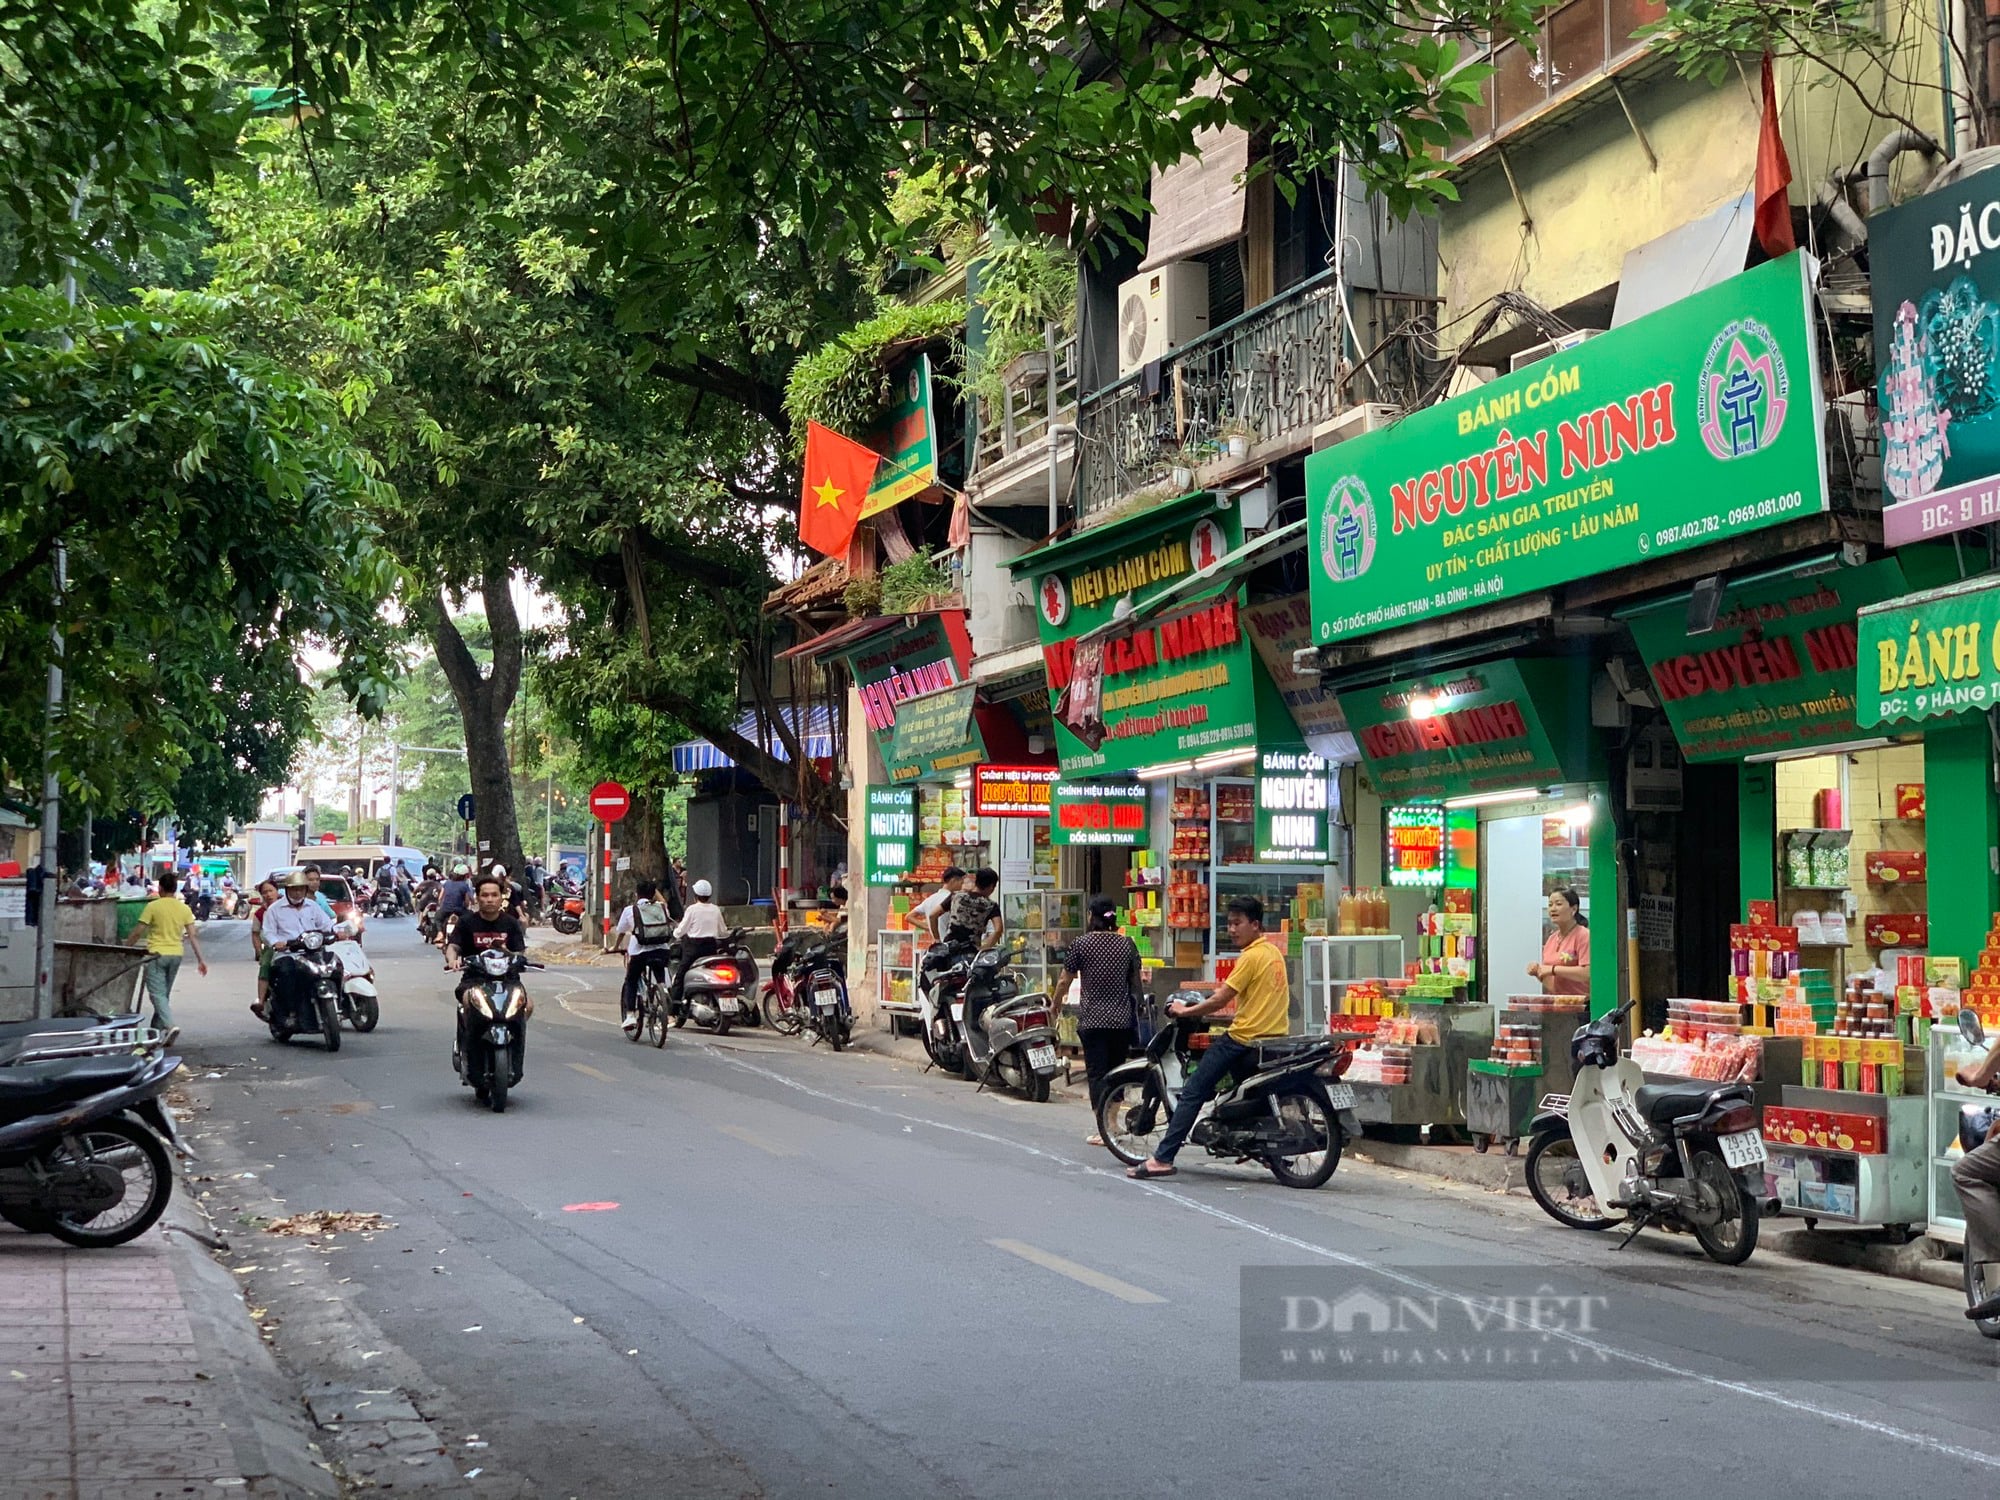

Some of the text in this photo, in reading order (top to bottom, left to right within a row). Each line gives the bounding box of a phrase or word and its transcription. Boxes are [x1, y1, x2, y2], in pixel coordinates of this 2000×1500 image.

[1930, 201, 2000, 271] ĐẶC
[1457, 364, 1580, 436] BÁNH CỐM
[1390, 428, 1549, 536] NGUYÊN
[1557, 382, 1678, 480] NINH
[1443, 476, 1615, 548] ĐẶC SẢN GIA TRUYỀN
[1655, 513, 1720, 547] 0987.402.782
[1728, 491, 1803, 526] 0969.081.000
[1922, 504, 1953, 532] ĐC:
[1960, 496, 1973, 521] 9
[1426, 563, 1444, 582] UY
[1445, 553, 1467, 578] TÍN
[1476, 536, 1511, 568] CHẤT
[1514, 527, 1561, 557] LƯỢNG
[1571, 515, 1600, 540] LÂU
[1603, 503, 1640, 530] NĂM
[1072, 567, 1104, 608] HIỆU
[1105, 556, 1147, 596] BÁNH
[1332, 615, 1344, 634] SỐ
[1349, 611, 1367, 628] DỐC
[1367, 604, 1383, 625] PHỐ
[1384, 601, 1407, 621] HÀNG
[1407, 598, 1430, 616] THAN
[1435, 594, 1447, 608] BA
[1447, 588, 1468, 605] ĐÌNH
[1473, 581, 1487, 598] HÀ
[1487, 576, 1504, 597] NỘI
[1160, 600, 1238, 660] NINH
[1652, 629, 1802, 701] NGUYÊN
[1878, 619, 1981, 694] BÁNH
[1778, 705, 1800, 720] GIA
[1801, 689, 1849, 716] TRUYỀN
[1880, 698, 1908, 716] ĐC:
[1915, 695, 1927, 711] 9
[1932, 685, 1986, 708] HÀNG
[1263, 752, 1325, 770] BÁNH CỐM
[871, 790, 912, 804] BÁNH CỐM
[982, 780, 1029, 801] NGUYÊN
[1057, 785, 1146, 798] CHÍNH HIỆU BÁNH CỐM
[1261, 772, 1327, 809] NGUYÊN
[871, 809, 914, 836] NGUYÊN
[1059, 800, 1145, 829] NGUYÊN NINH
[1271, 816, 1316, 846] NINH
[1069, 830, 1134, 843] DỐC HÀNG THAN
[877, 843, 906, 866] NINH
[1725, 1132, 1758, 1150] 29-T3
[1730, 1147, 1763, 1165] 7359
